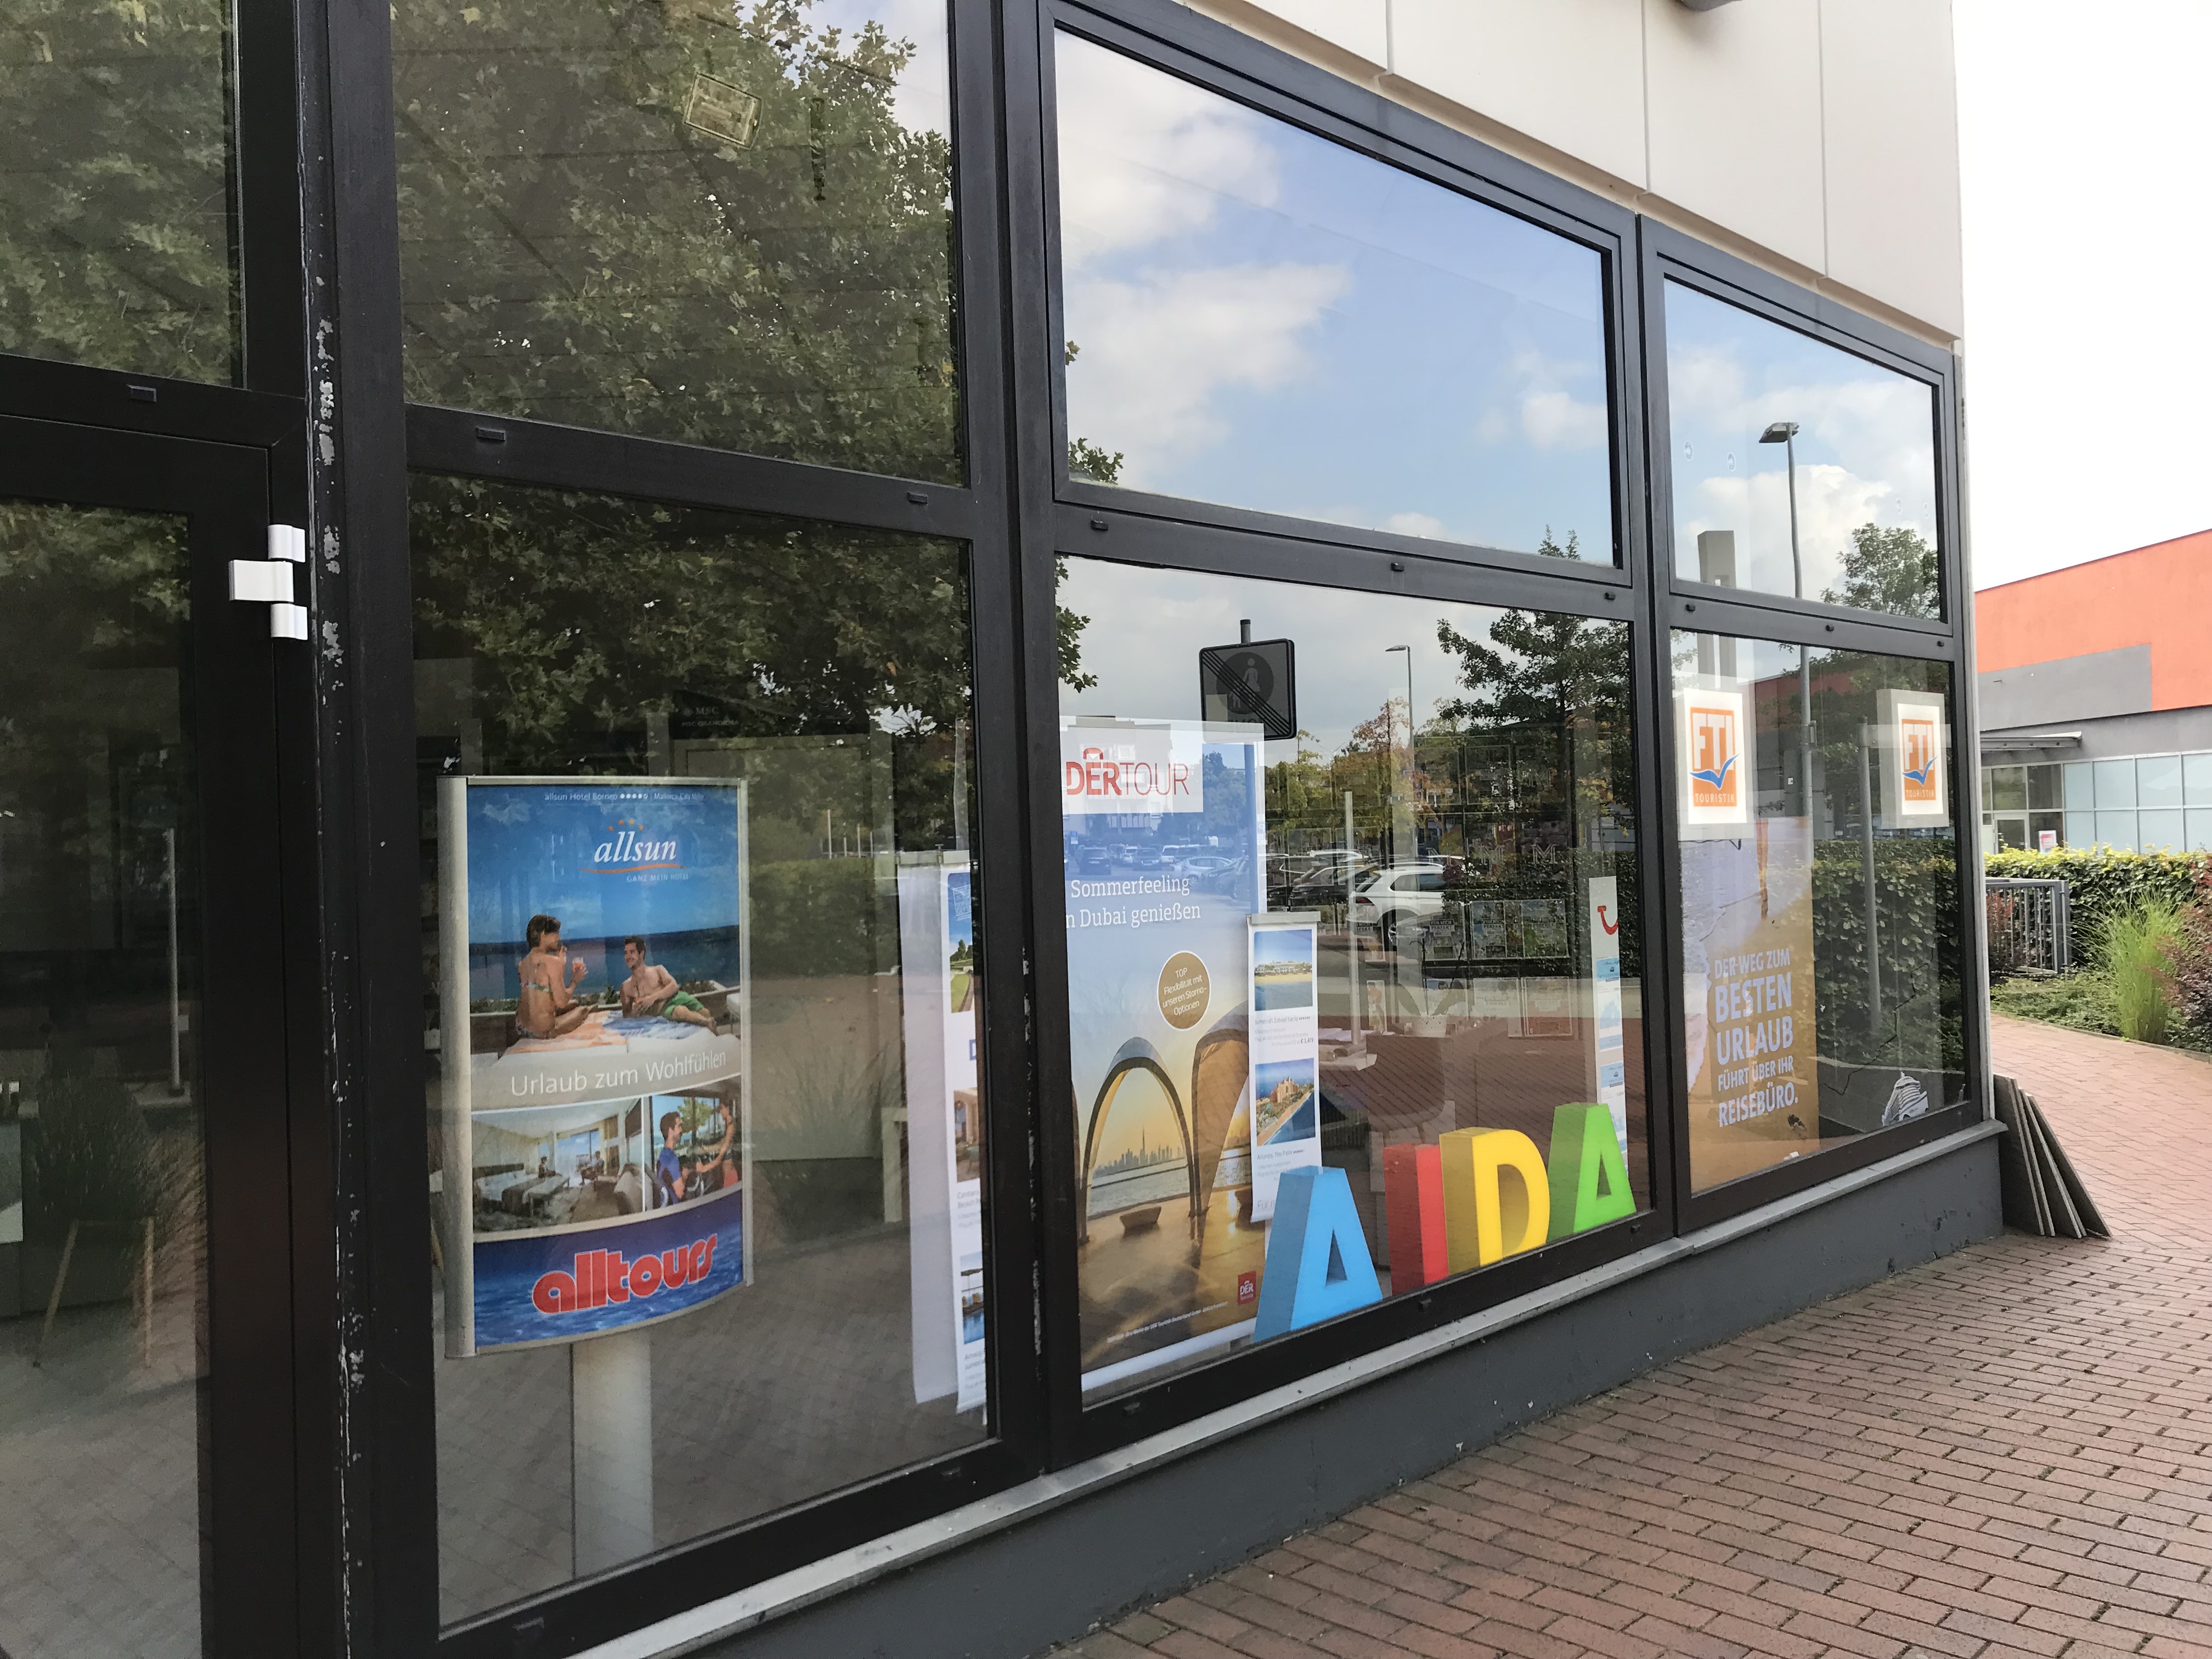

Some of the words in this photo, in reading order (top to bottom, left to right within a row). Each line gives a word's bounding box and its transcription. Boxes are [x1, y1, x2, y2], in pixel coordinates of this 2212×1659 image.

[696, 707, 719, 715] MSC
[1692, 712, 1734, 770] FTI
[1904, 723, 1934, 770] FTI
[1065, 760, 1190, 795] DERTOUR
[570, 792, 591, 800] Hotel
[1695, 793, 1735, 803] TOURISTIK
[1905, 789, 1934, 798] TOURISTIK
[594, 831, 676, 862] allsun
[1071, 874, 1190, 898] Sommerfeeling
[1080, 906, 1127, 927] Dubai
[1131, 902, 1201, 928] genießen
[1175, 967, 1188, 978] TOP
[1714, 957, 1736, 979] DER
[1738, 952, 1764, 974] WEG
[1767, 947, 1791, 969] ZUM
[1162, 993, 1186, 1008] unseren
[1185, 988, 1207, 1000] Storno-
[1164, 979, 1192, 995] Flexibilität
[1193, 974, 1203, 984] mit
[1715, 972, 1792, 1023] BESTEN
[1173, 1001, 1200, 1016] Optionen
[1717, 1015, 1793, 1065] URLAUB
[511, 1070, 587, 1096] Urlaub
[595, 1068, 638, 1089] zum
[646, 1051, 726, 1082] Wohlfühlen
[1718, 1066, 1749, 1092] FÜHRT
[1752, 1060, 1776, 1082] ÜBER
[1778, 1056, 1794, 1074] IHR
[1719, 1082, 1798, 1127] REISEBÜRO.
[1255, 1102, 1637, 1342] AIDA
[532, 1233, 718, 1314] alltours
[1240, 1282, 1254, 1295] DER
